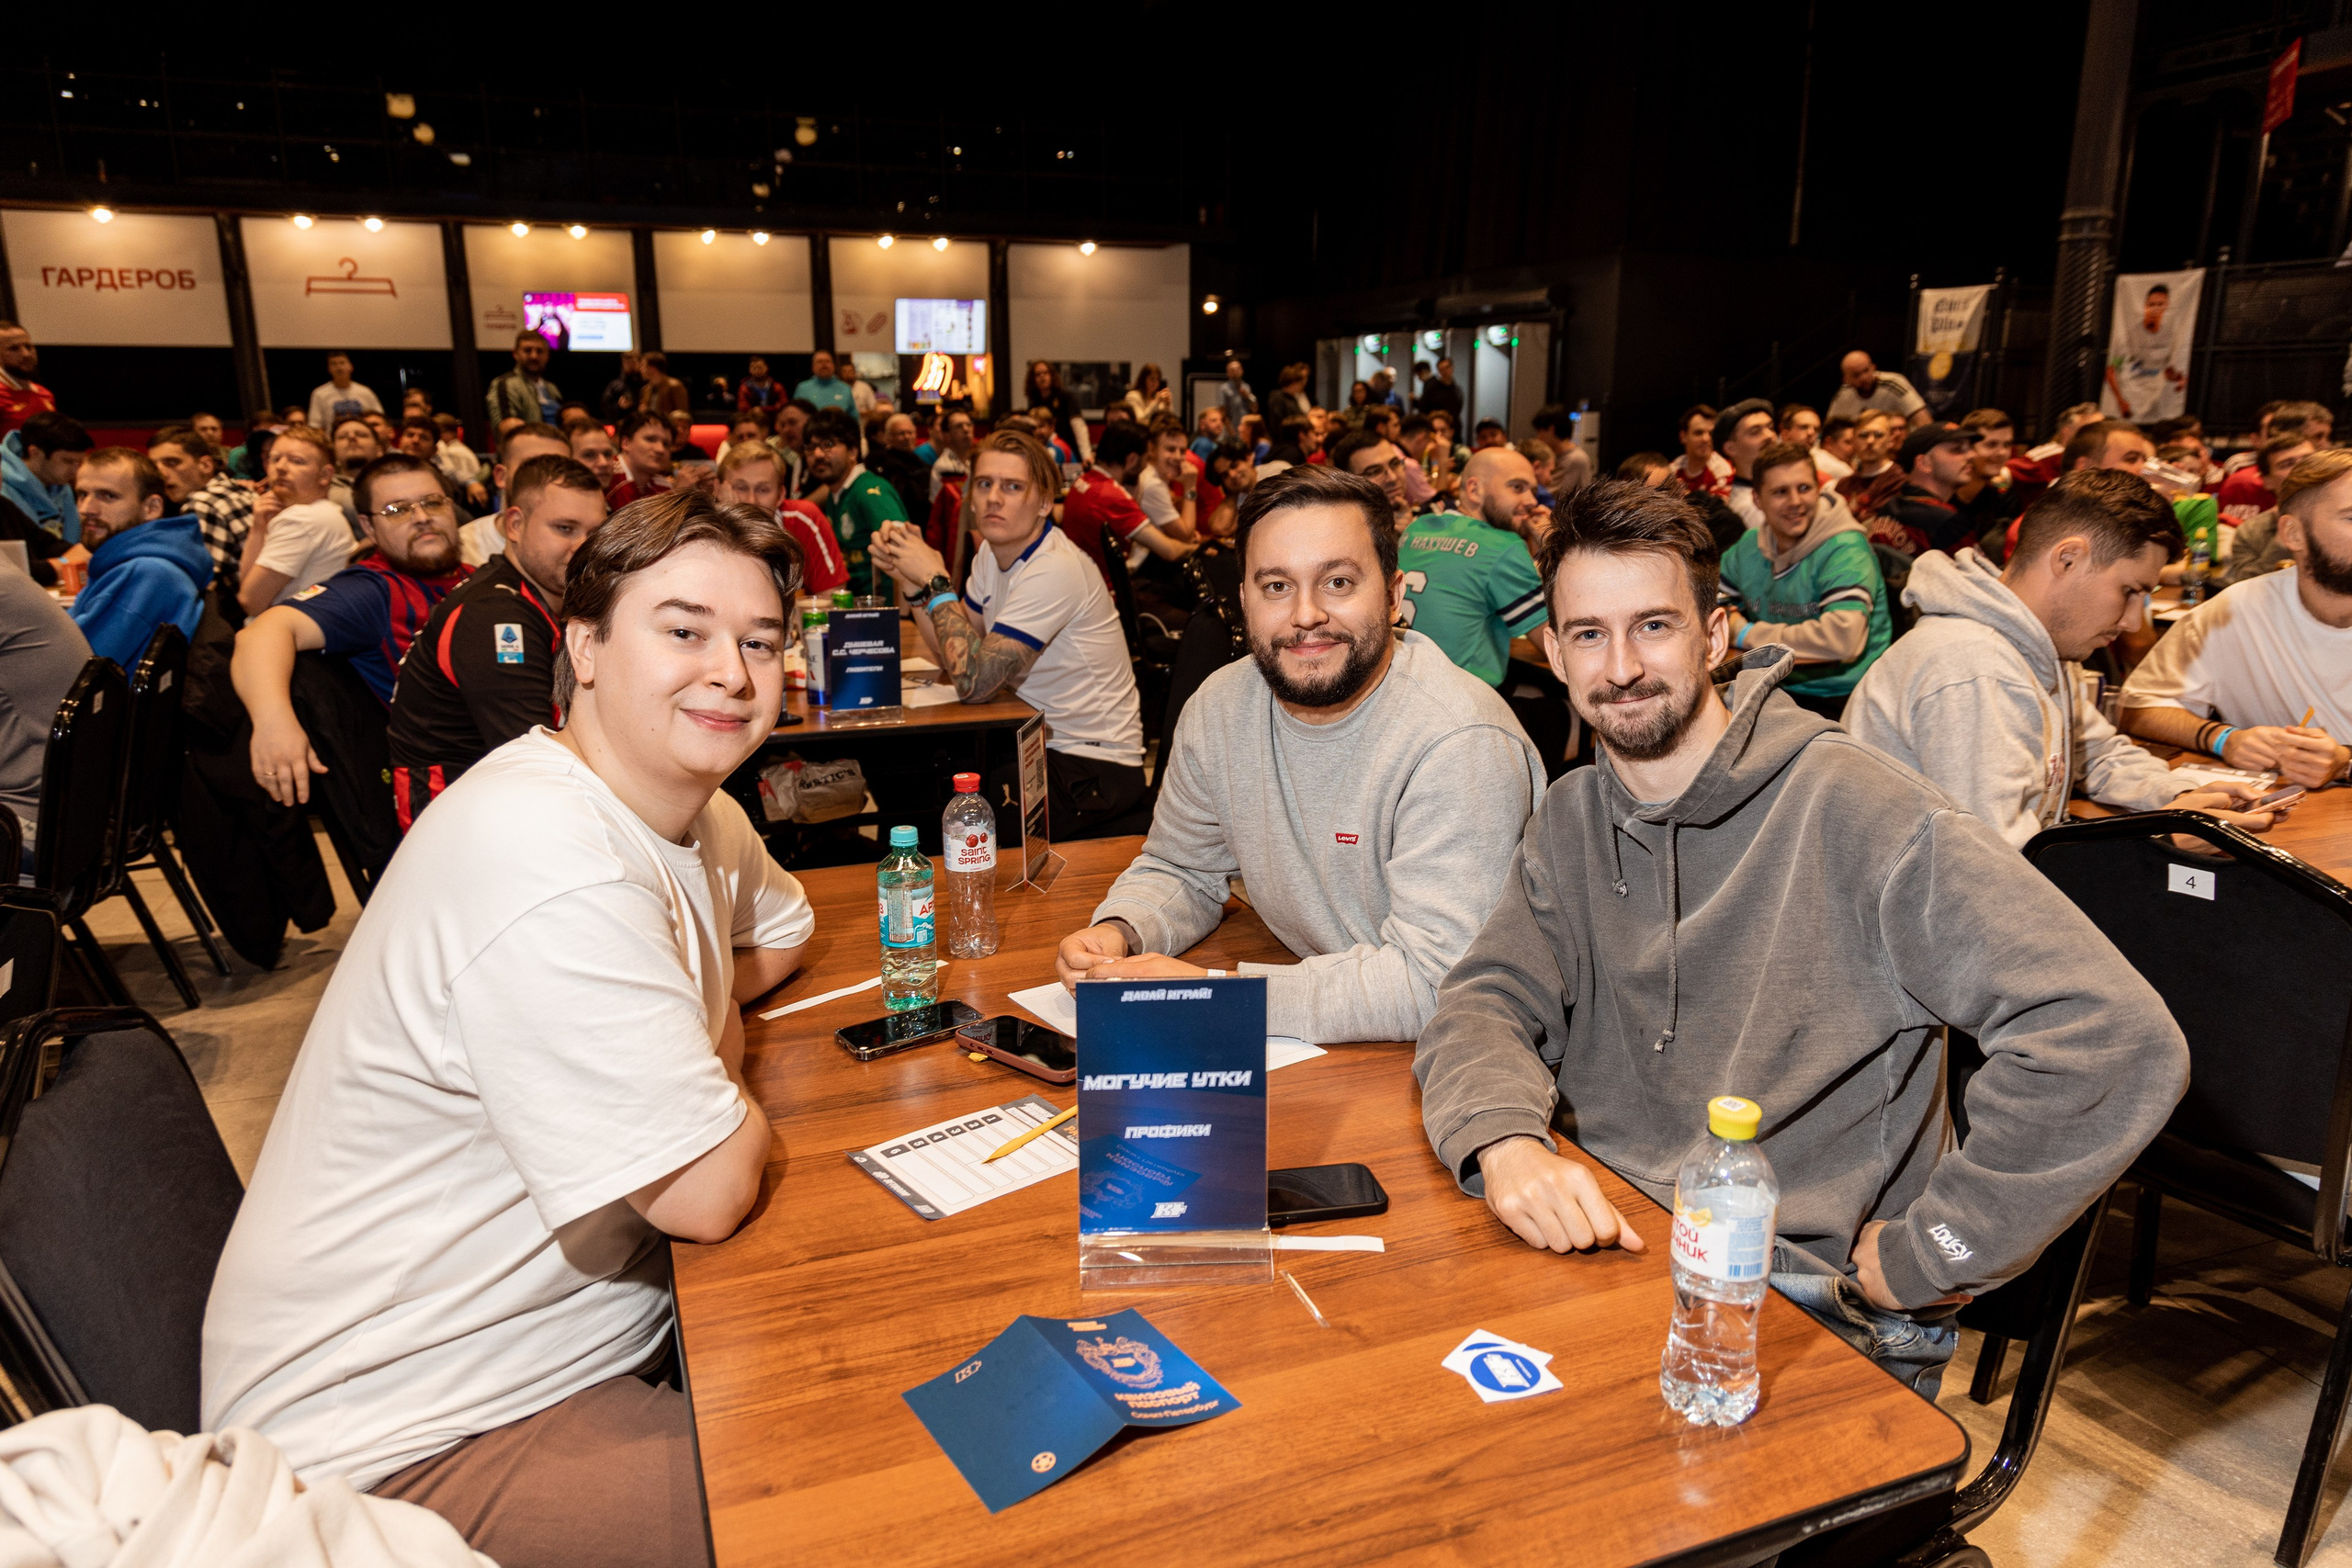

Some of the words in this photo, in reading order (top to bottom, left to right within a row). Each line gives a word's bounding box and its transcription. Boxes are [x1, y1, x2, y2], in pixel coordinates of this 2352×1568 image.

[41, 266, 197, 292] ГАРДЕРОБ
[1410, 536, 1479, 558] НАХУШЕВ
[848, 647, 896, 656] ЧЕРЧЕСОВА
[2186, 875, 2197, 889] 4
[1121, 988, 1167, 1002] ДАВАЙ
[1167, 987, 1213, 1000] ИГРАЙ!
[1083, 1073, 1188, 1090] МОГУЧИЕ
[1192, 1070, 1252, 1088] УТКИ
[1125, 1124, 1212, 1139] ПРОФИКИ
